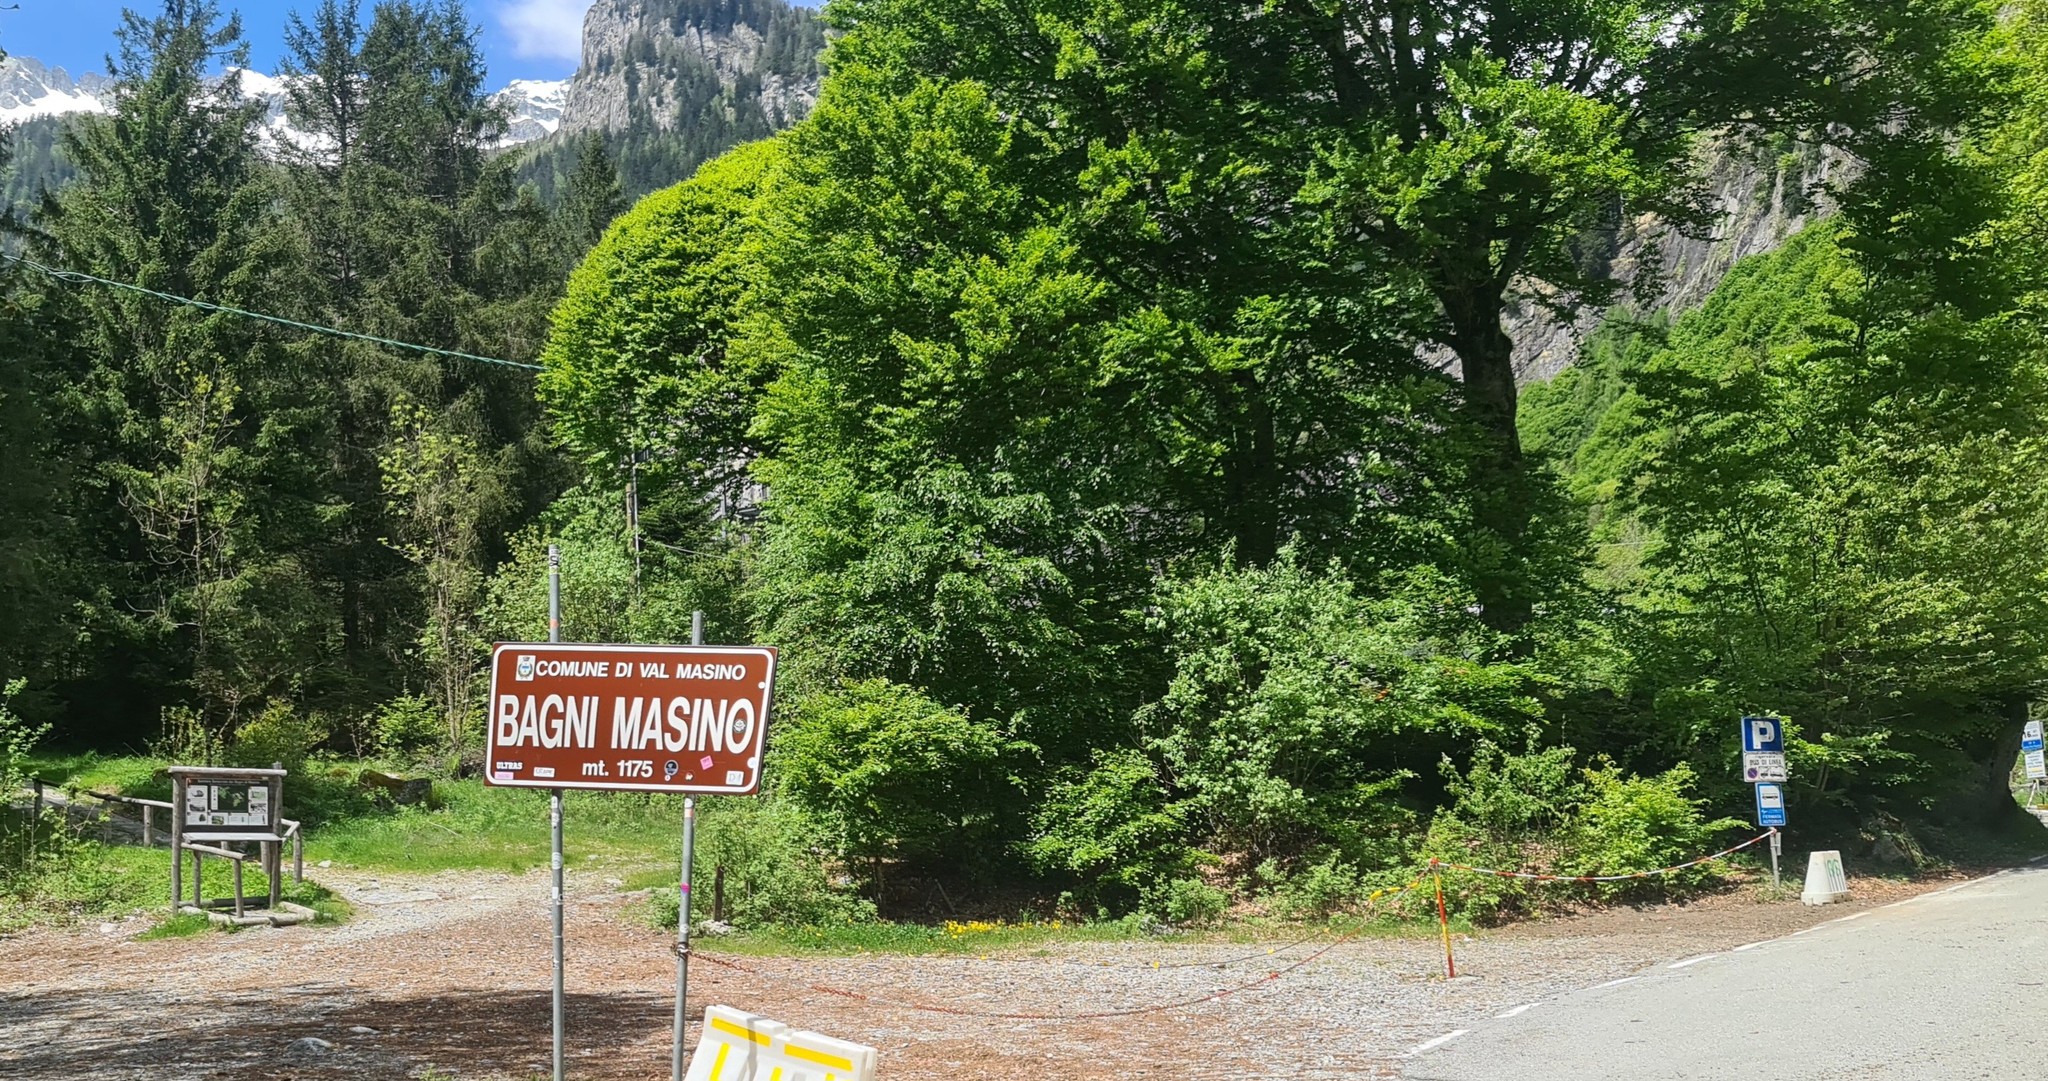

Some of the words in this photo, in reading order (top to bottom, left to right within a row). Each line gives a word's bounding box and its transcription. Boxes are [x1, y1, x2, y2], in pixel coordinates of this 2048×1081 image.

[535, 660, 610, 678] COMUNE
[615, 662, 634, 678] DI
[640, 663, 670, 679] VAL
[675, 664, 747, 681] MASINO
[496, 694, 600, 749] BAGNI
[610, 696, 755, 755] MASINO
[1751, 720, 1775, 749] P
[582, 760, 610, 777] mt.
[617, 760, 654, 778] 1175
